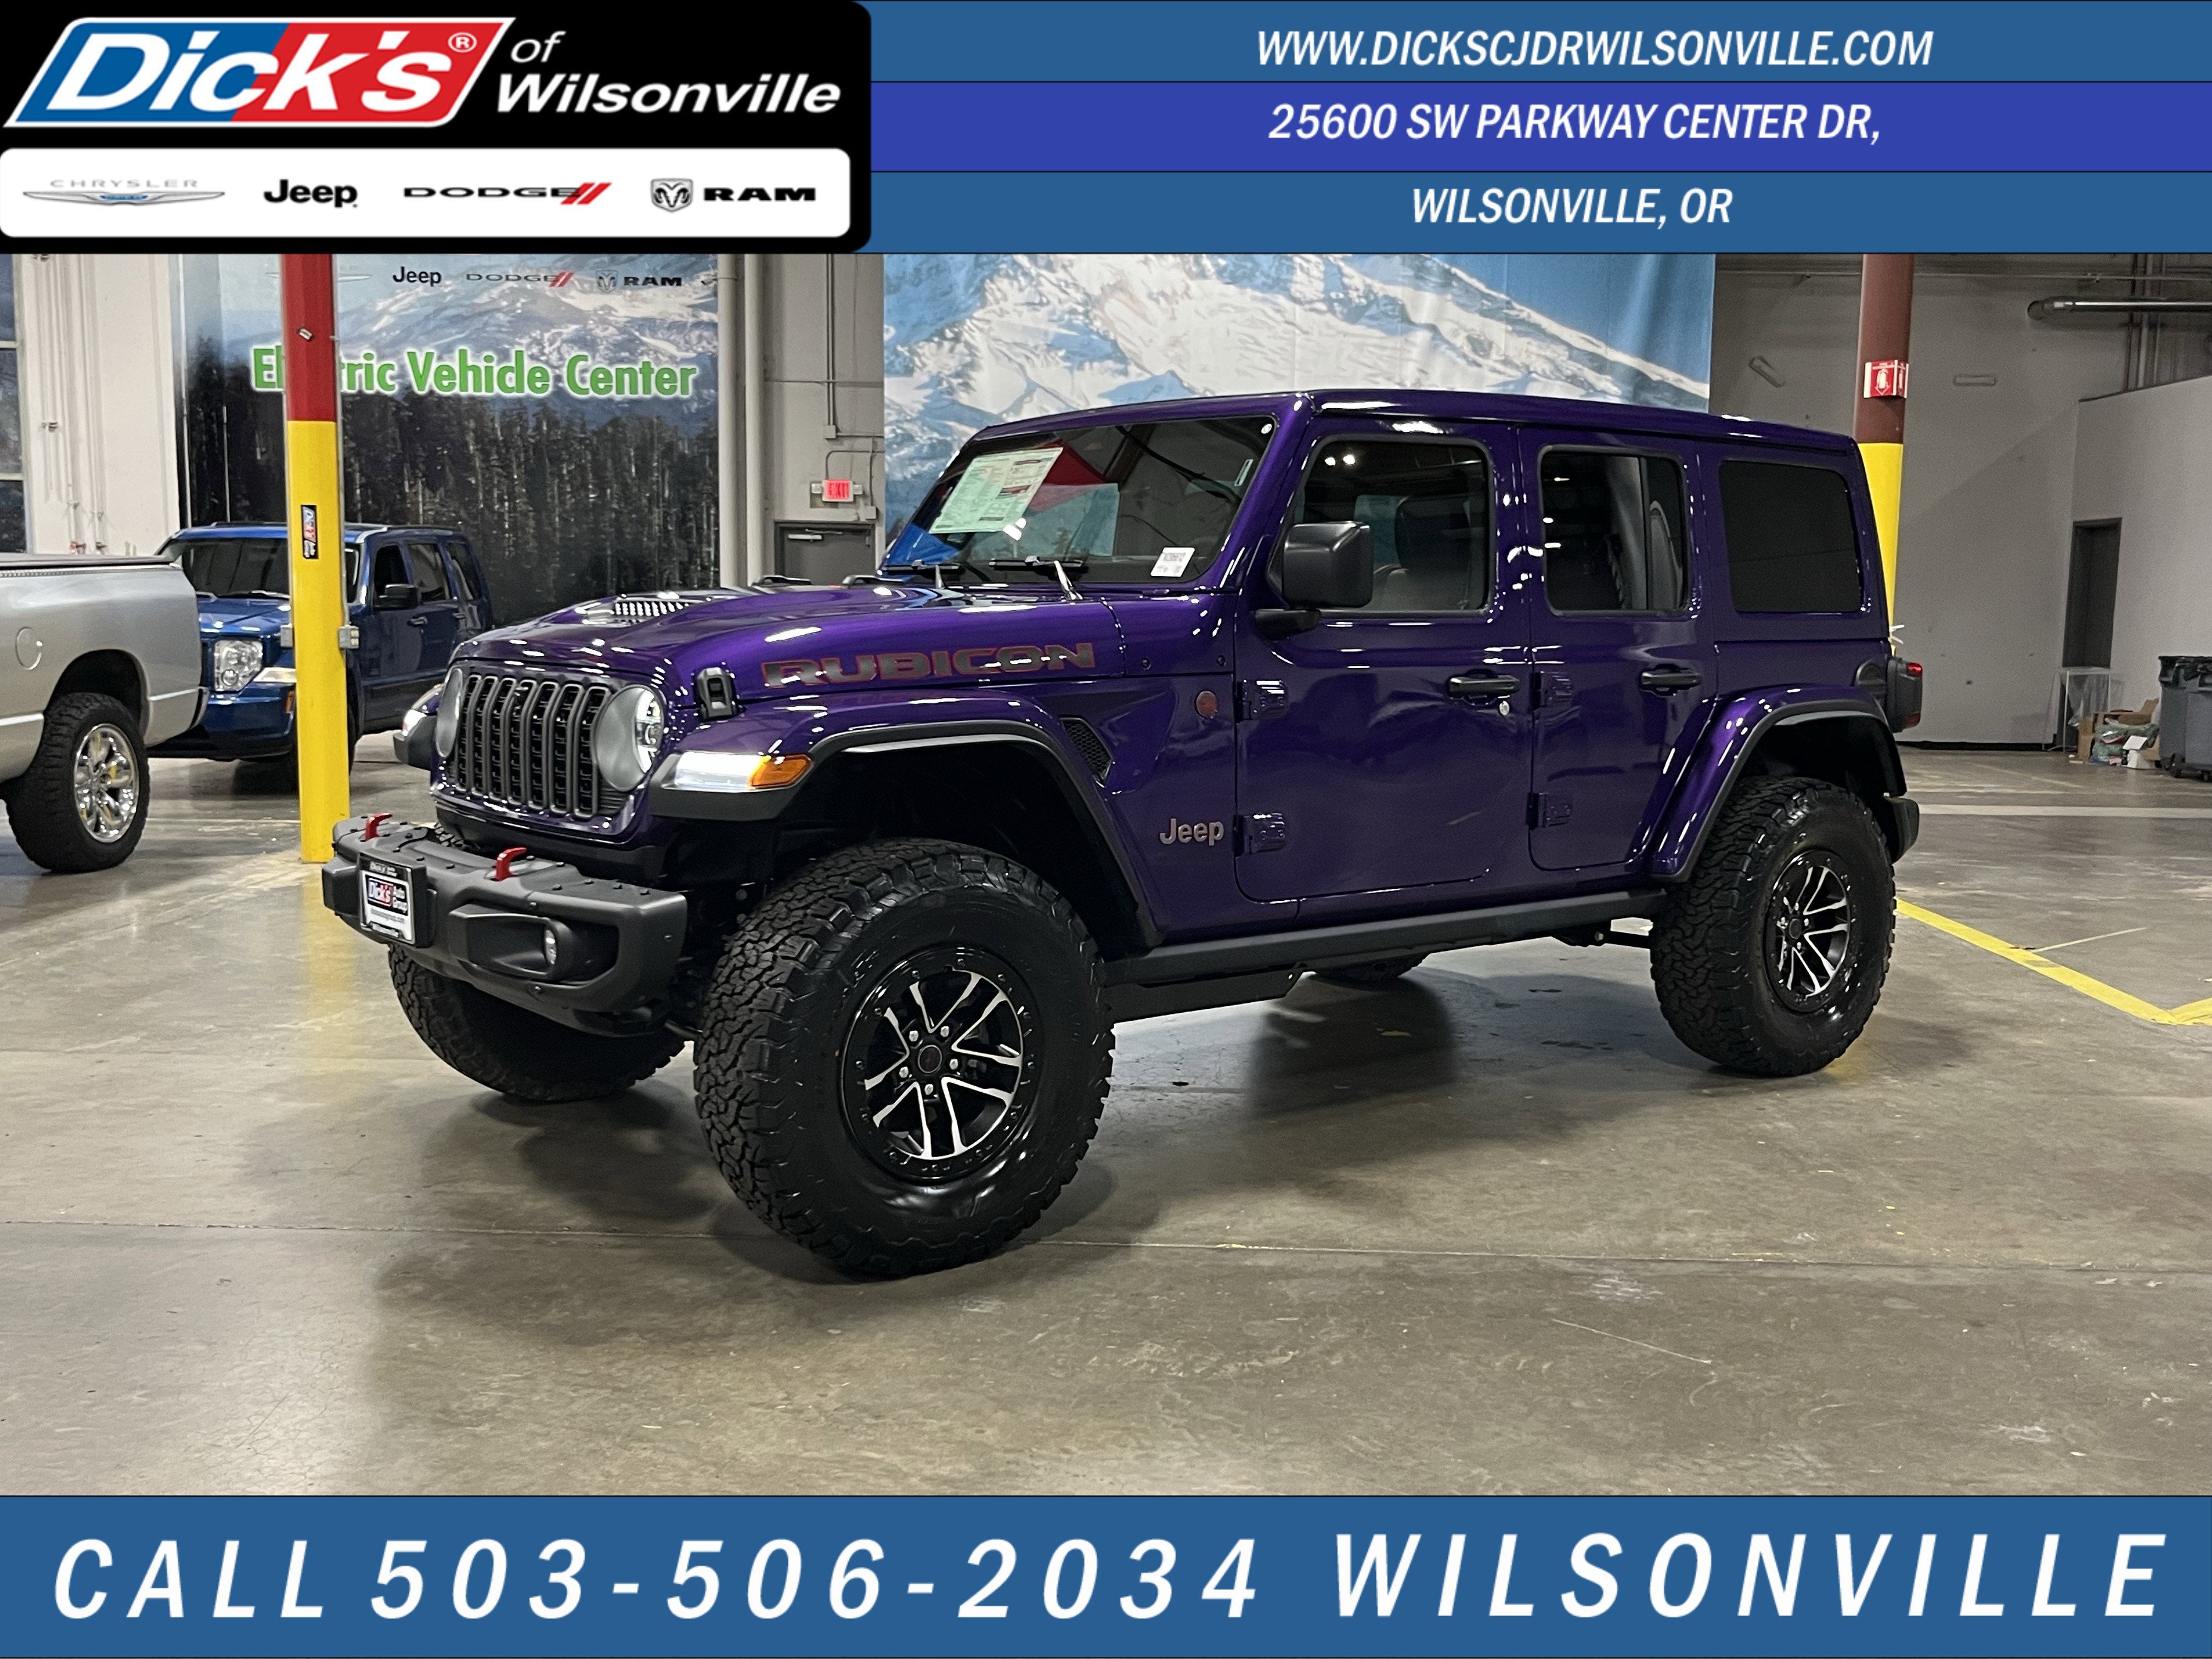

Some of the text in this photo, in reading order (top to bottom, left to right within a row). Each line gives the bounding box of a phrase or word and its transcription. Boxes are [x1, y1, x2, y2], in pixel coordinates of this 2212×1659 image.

[393, 266, 682, 287] Jeep DODGE RAM
[253, 345, 696, 396] Elric Vehicle Center
[827, 482, 850, 499] EXIT
[761, 642, 1095, 688] RUBICON
[1159, 818, 1224, 847] Jeep
